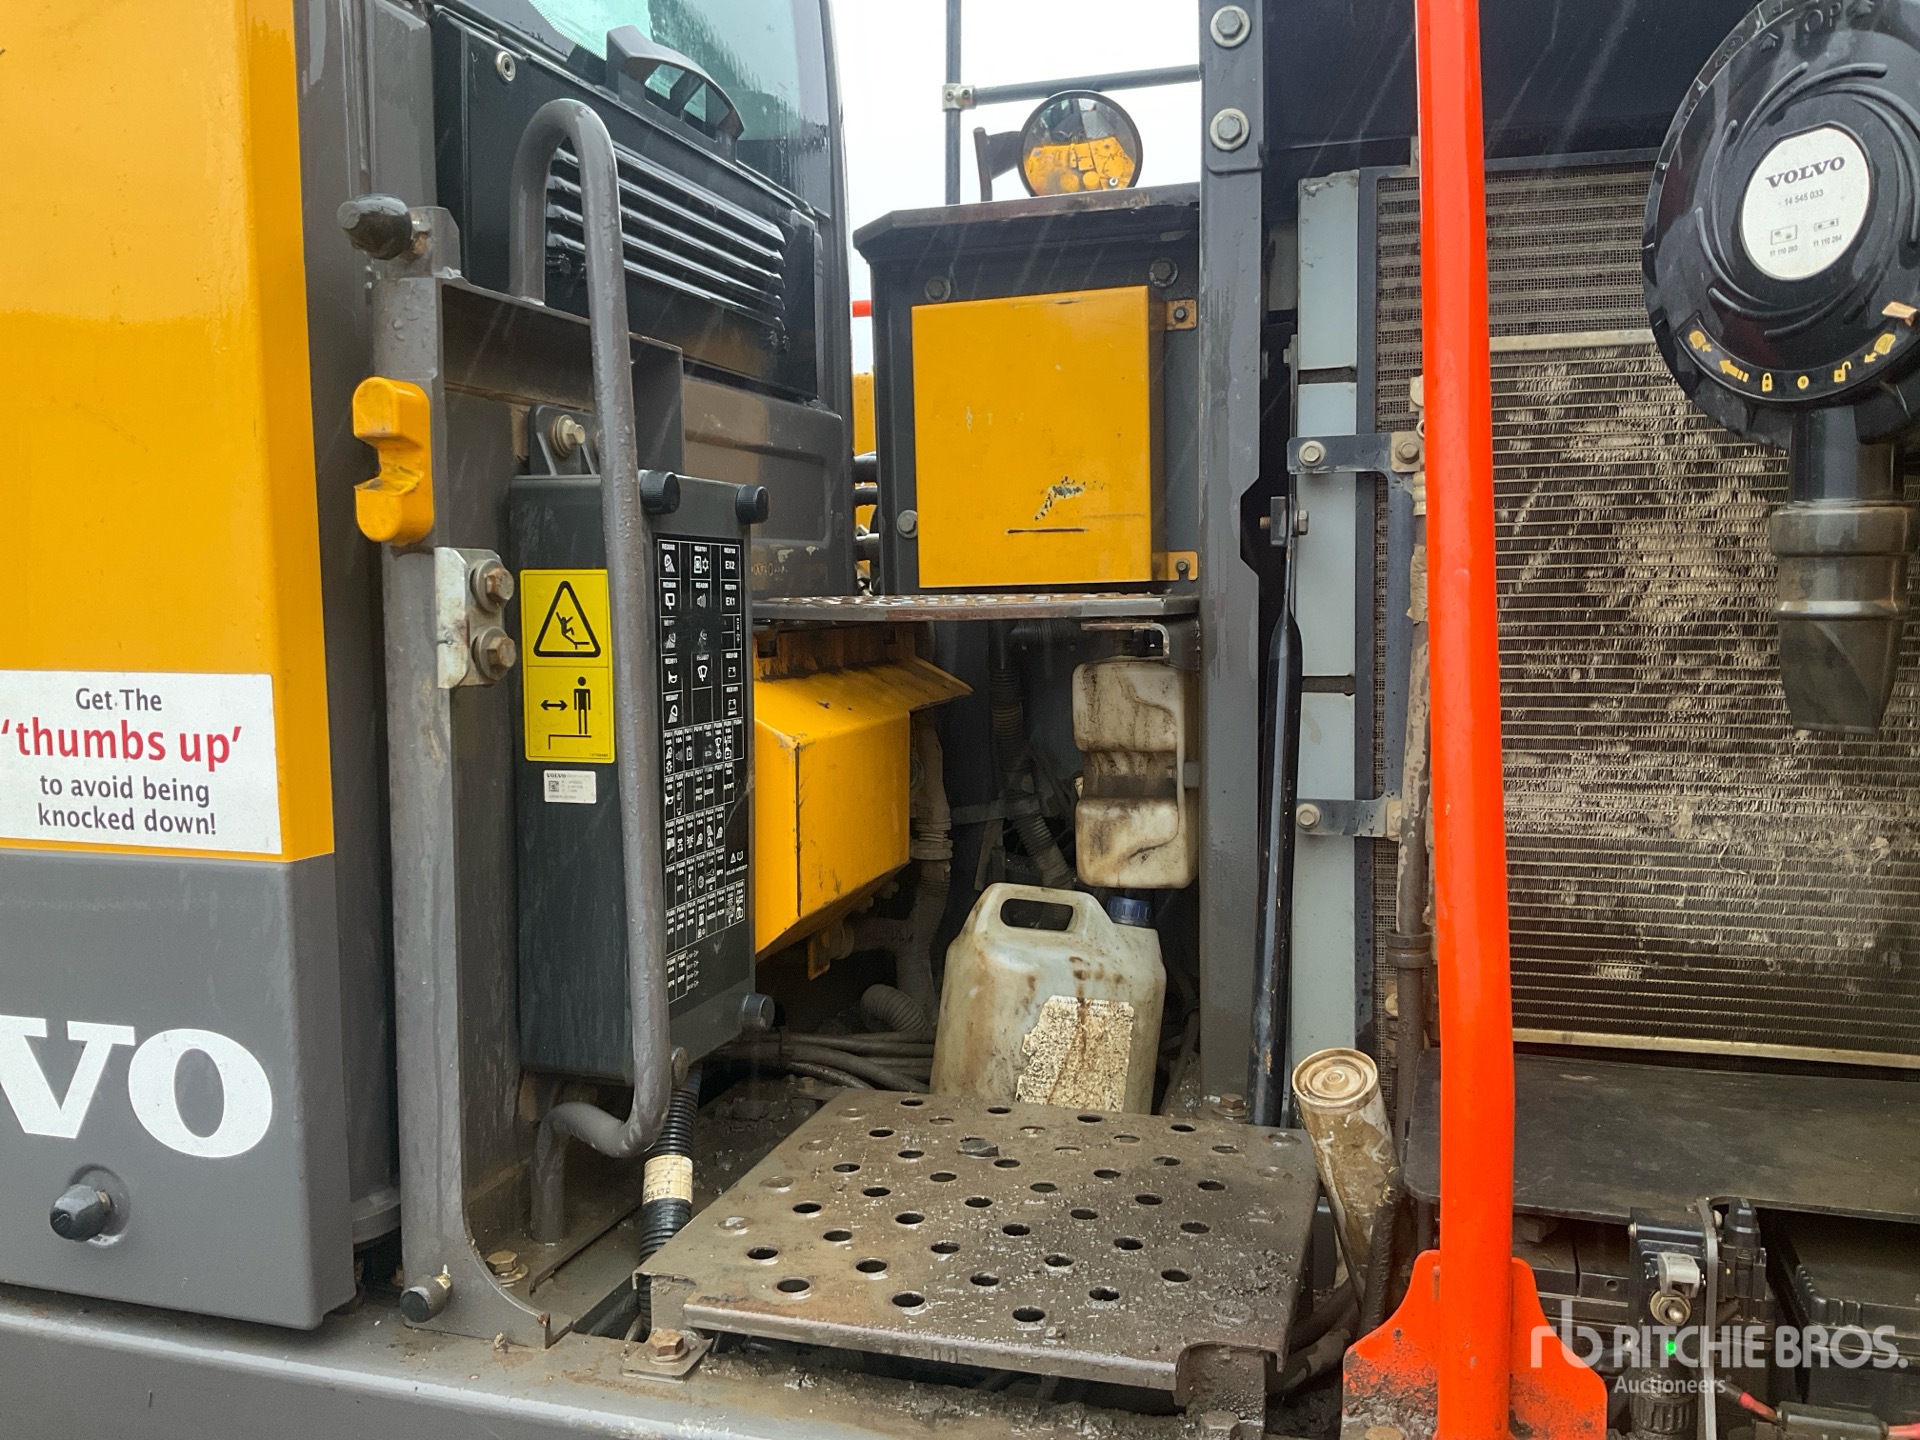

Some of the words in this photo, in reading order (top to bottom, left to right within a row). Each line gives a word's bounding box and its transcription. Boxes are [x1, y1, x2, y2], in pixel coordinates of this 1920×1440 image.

[1765, 156, 1846, 188] VOLVO
[1785, 197, 1793, 206] 14
[1795, 193, 1808, 204] 545
[1809, 188, 1824, 200] 033
[726, 596, 735, 606] EX1
[75, 688, 113, 711] Get
[119, 688, 163, 711] The
[40, 774, 63, 796] to
[71, 775, 134, 799] avoid
[143, 776, 210, 808] being
[37, 803, 135, 831] knocked
[144, 808, 217, 835] down!
